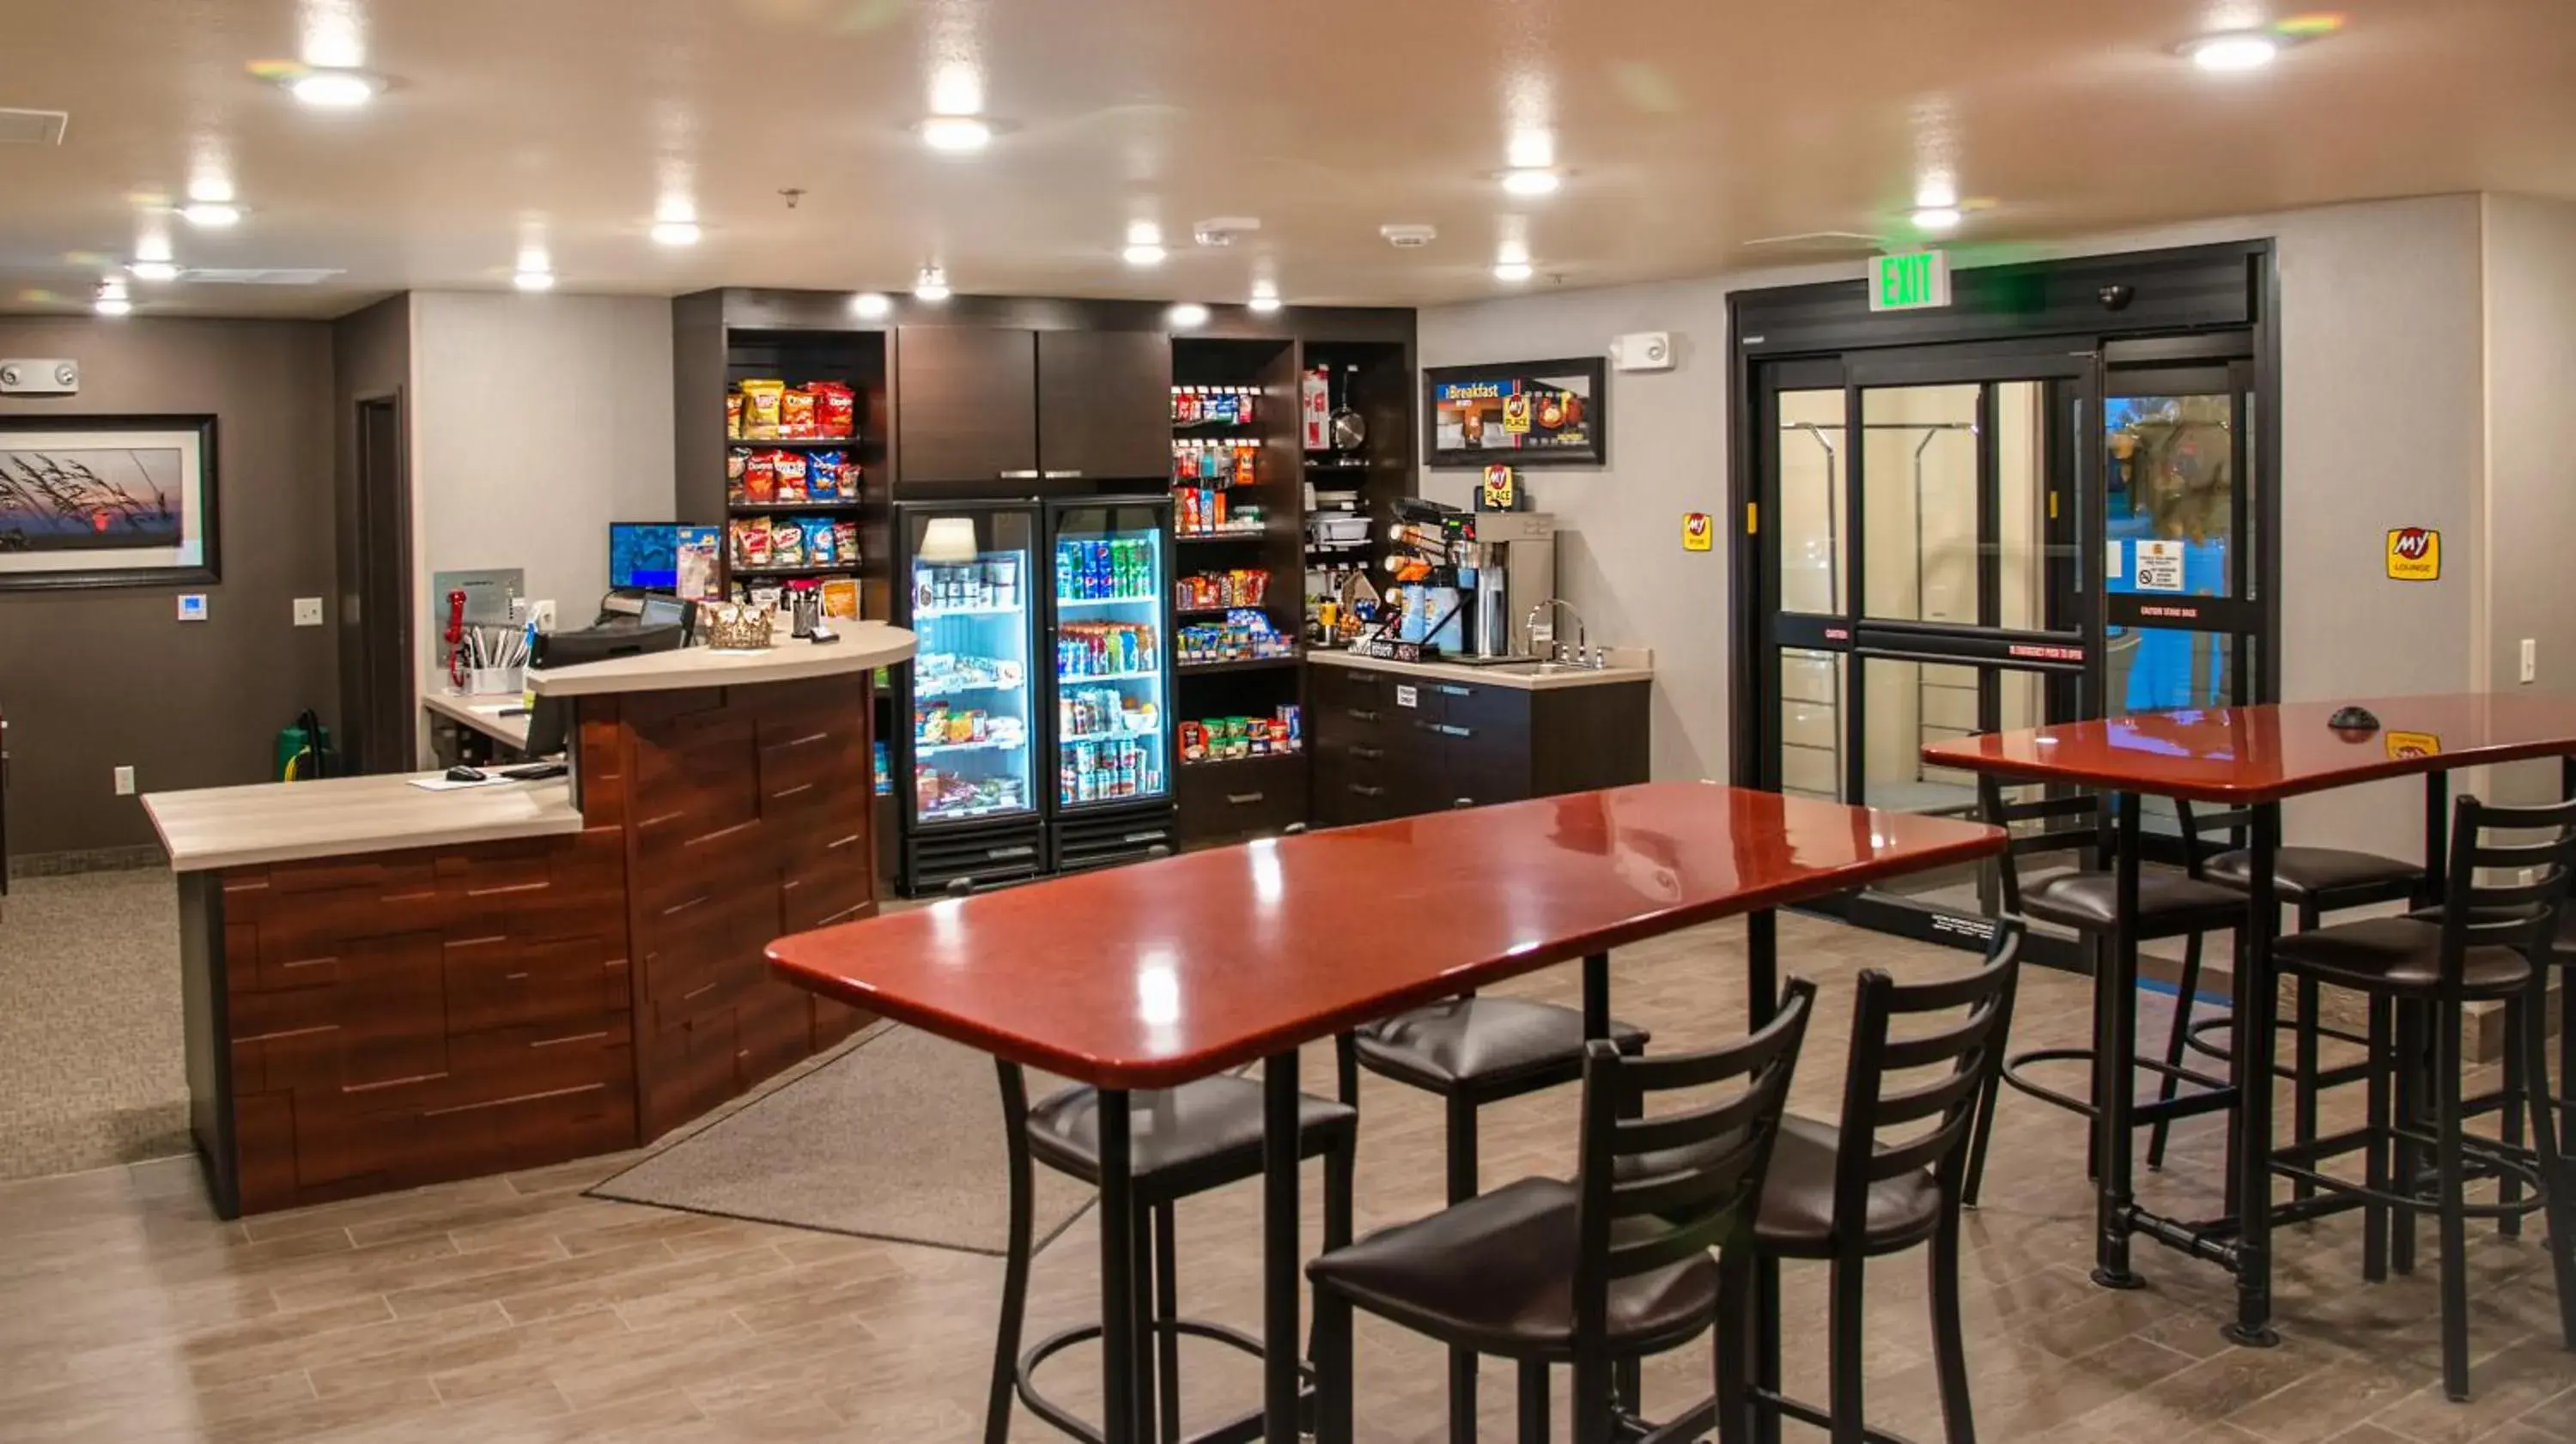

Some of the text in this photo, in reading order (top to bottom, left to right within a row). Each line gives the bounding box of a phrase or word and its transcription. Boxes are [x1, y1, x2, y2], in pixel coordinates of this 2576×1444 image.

[1881, 252, 1932, 306] EXIT
[1449, 383, 1498, 399] Breakfast
[1505, 417, 1528, 427] PLACE
[1486, 490, 1511, 501] PLACE
[2394, 562, 2431, 573] LOUNGE
